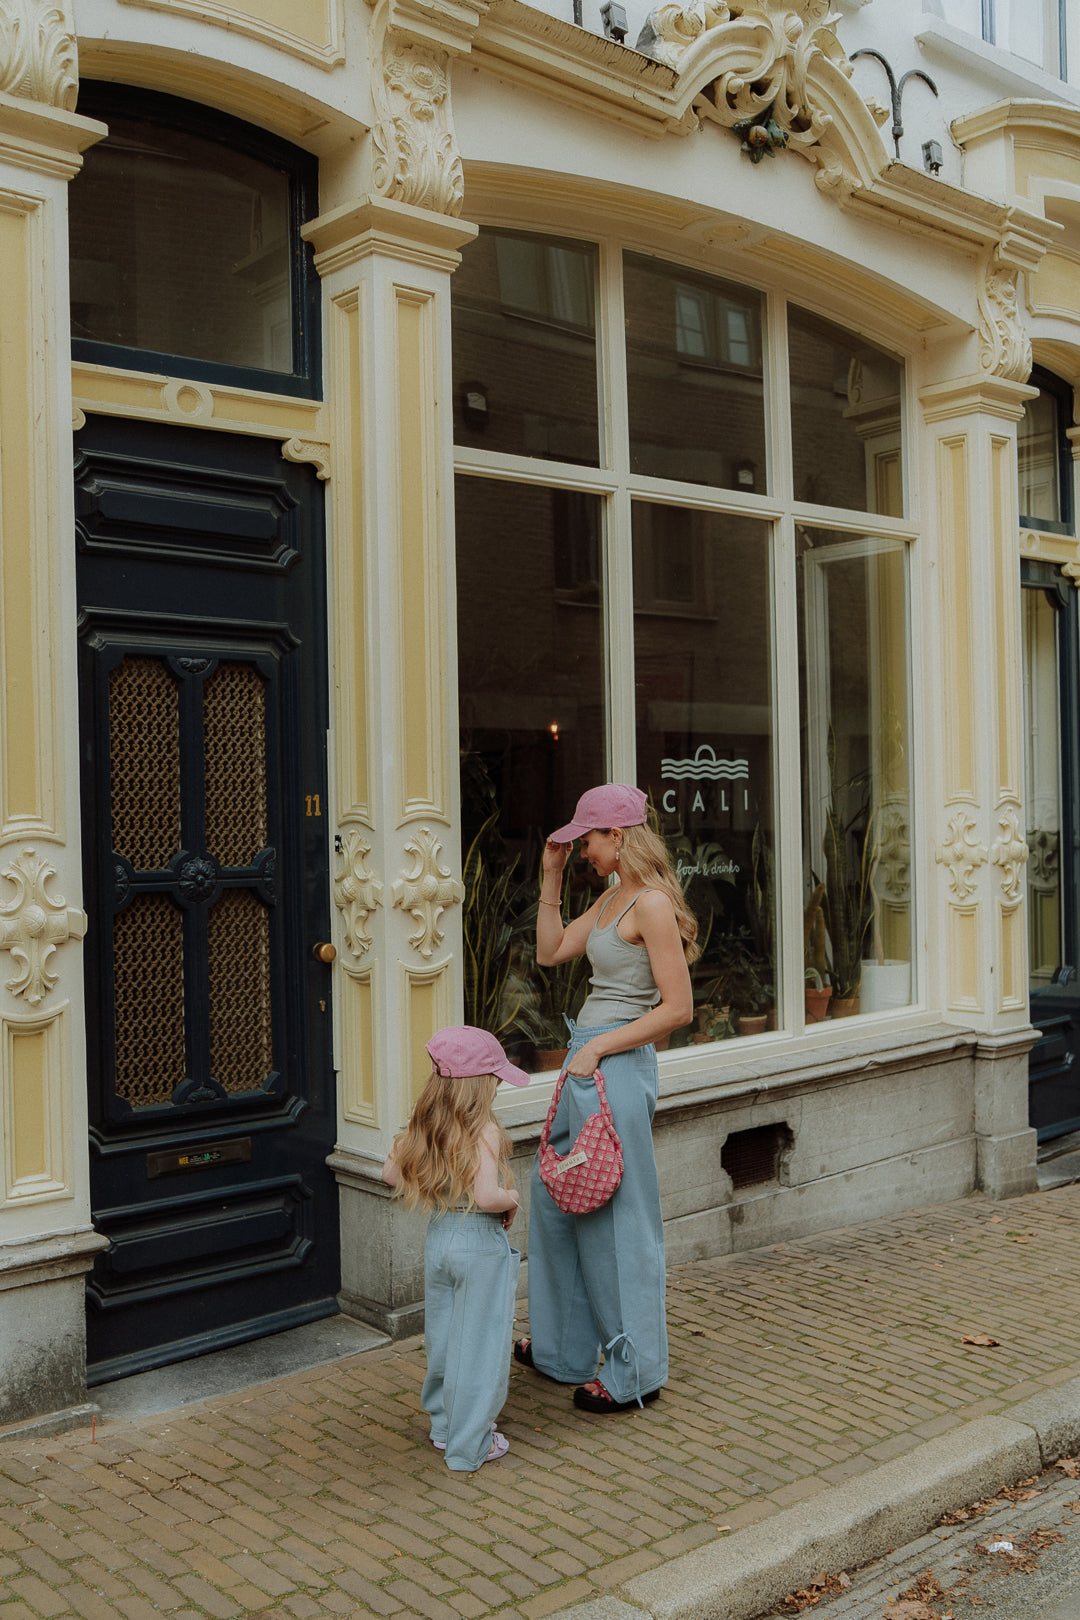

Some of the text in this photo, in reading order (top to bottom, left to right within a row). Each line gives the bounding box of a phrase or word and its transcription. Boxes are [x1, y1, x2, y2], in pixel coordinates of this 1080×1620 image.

[305, 794, 321, 816] 11
[662, 789, 749, 813] CALI
[676, 859, 740, 882] food & drinks
